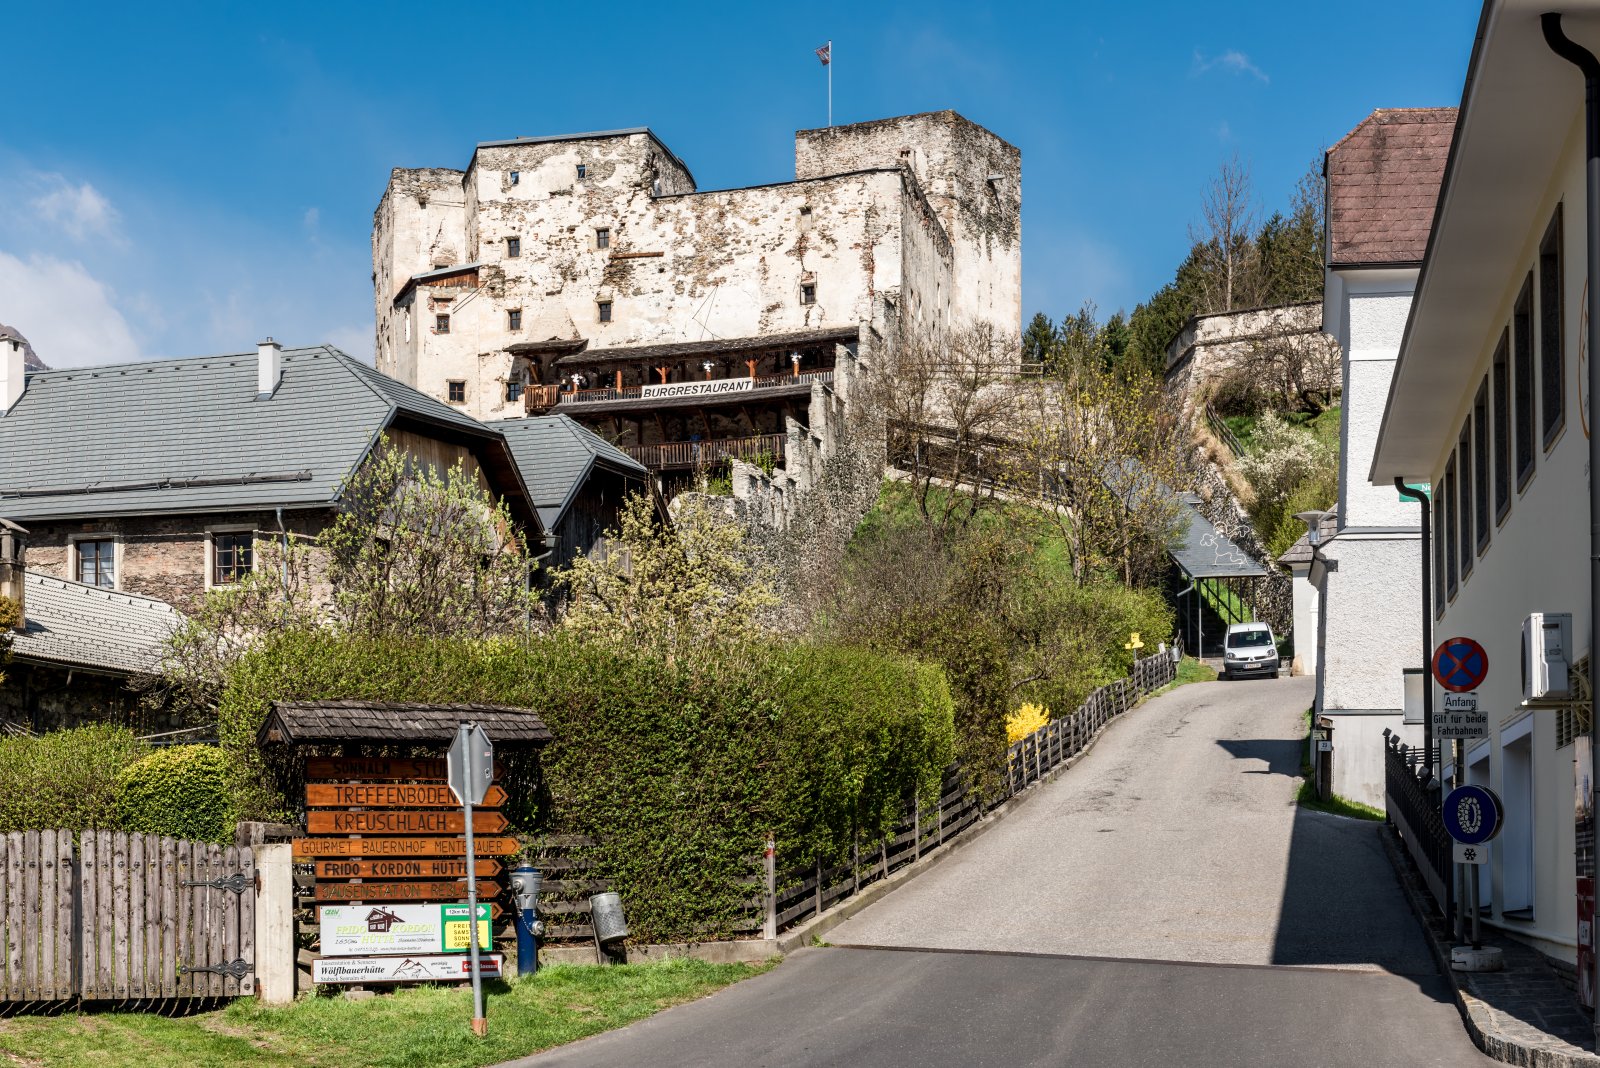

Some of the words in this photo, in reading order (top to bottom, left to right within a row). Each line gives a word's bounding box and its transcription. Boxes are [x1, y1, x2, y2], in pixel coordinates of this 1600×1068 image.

[643, 380, 752, 398] BURGRESTAURANT
[1445, 696, 1477, 710] Anfang
[1433, 714, 1447, 724] Gilt
[1465, 713, 1487, 724] beide
[1437, 726, 1483, 736] Fahrbahnen
[333, 760, 391, 776] SONNALM
[412, 761, 448, 779] STU
[334, 786, 458, 805] TREFFENBODEN
[334, 813, 447, 831] KREUSCHLACH
[301, 840, 352, 854] GOURMET
[362, 840, 427, 854] BAUERNHOF
[434, 840, 503, 854] MENTEAUER
[324, 863, 360, 876] FRIDO
[371, 863, 421, 876] KORDON
[322, 884, 420, 899] JAUSENSTATION
[431, 882, 483, 897] REBLAS
[335, 925, 367, 935] FRIDO
[391, 923, 436, 934] KORDON
[361, 933, 395, 944] HÜTTE
[321, 965, 386, 977] Wölflbauerhütte
